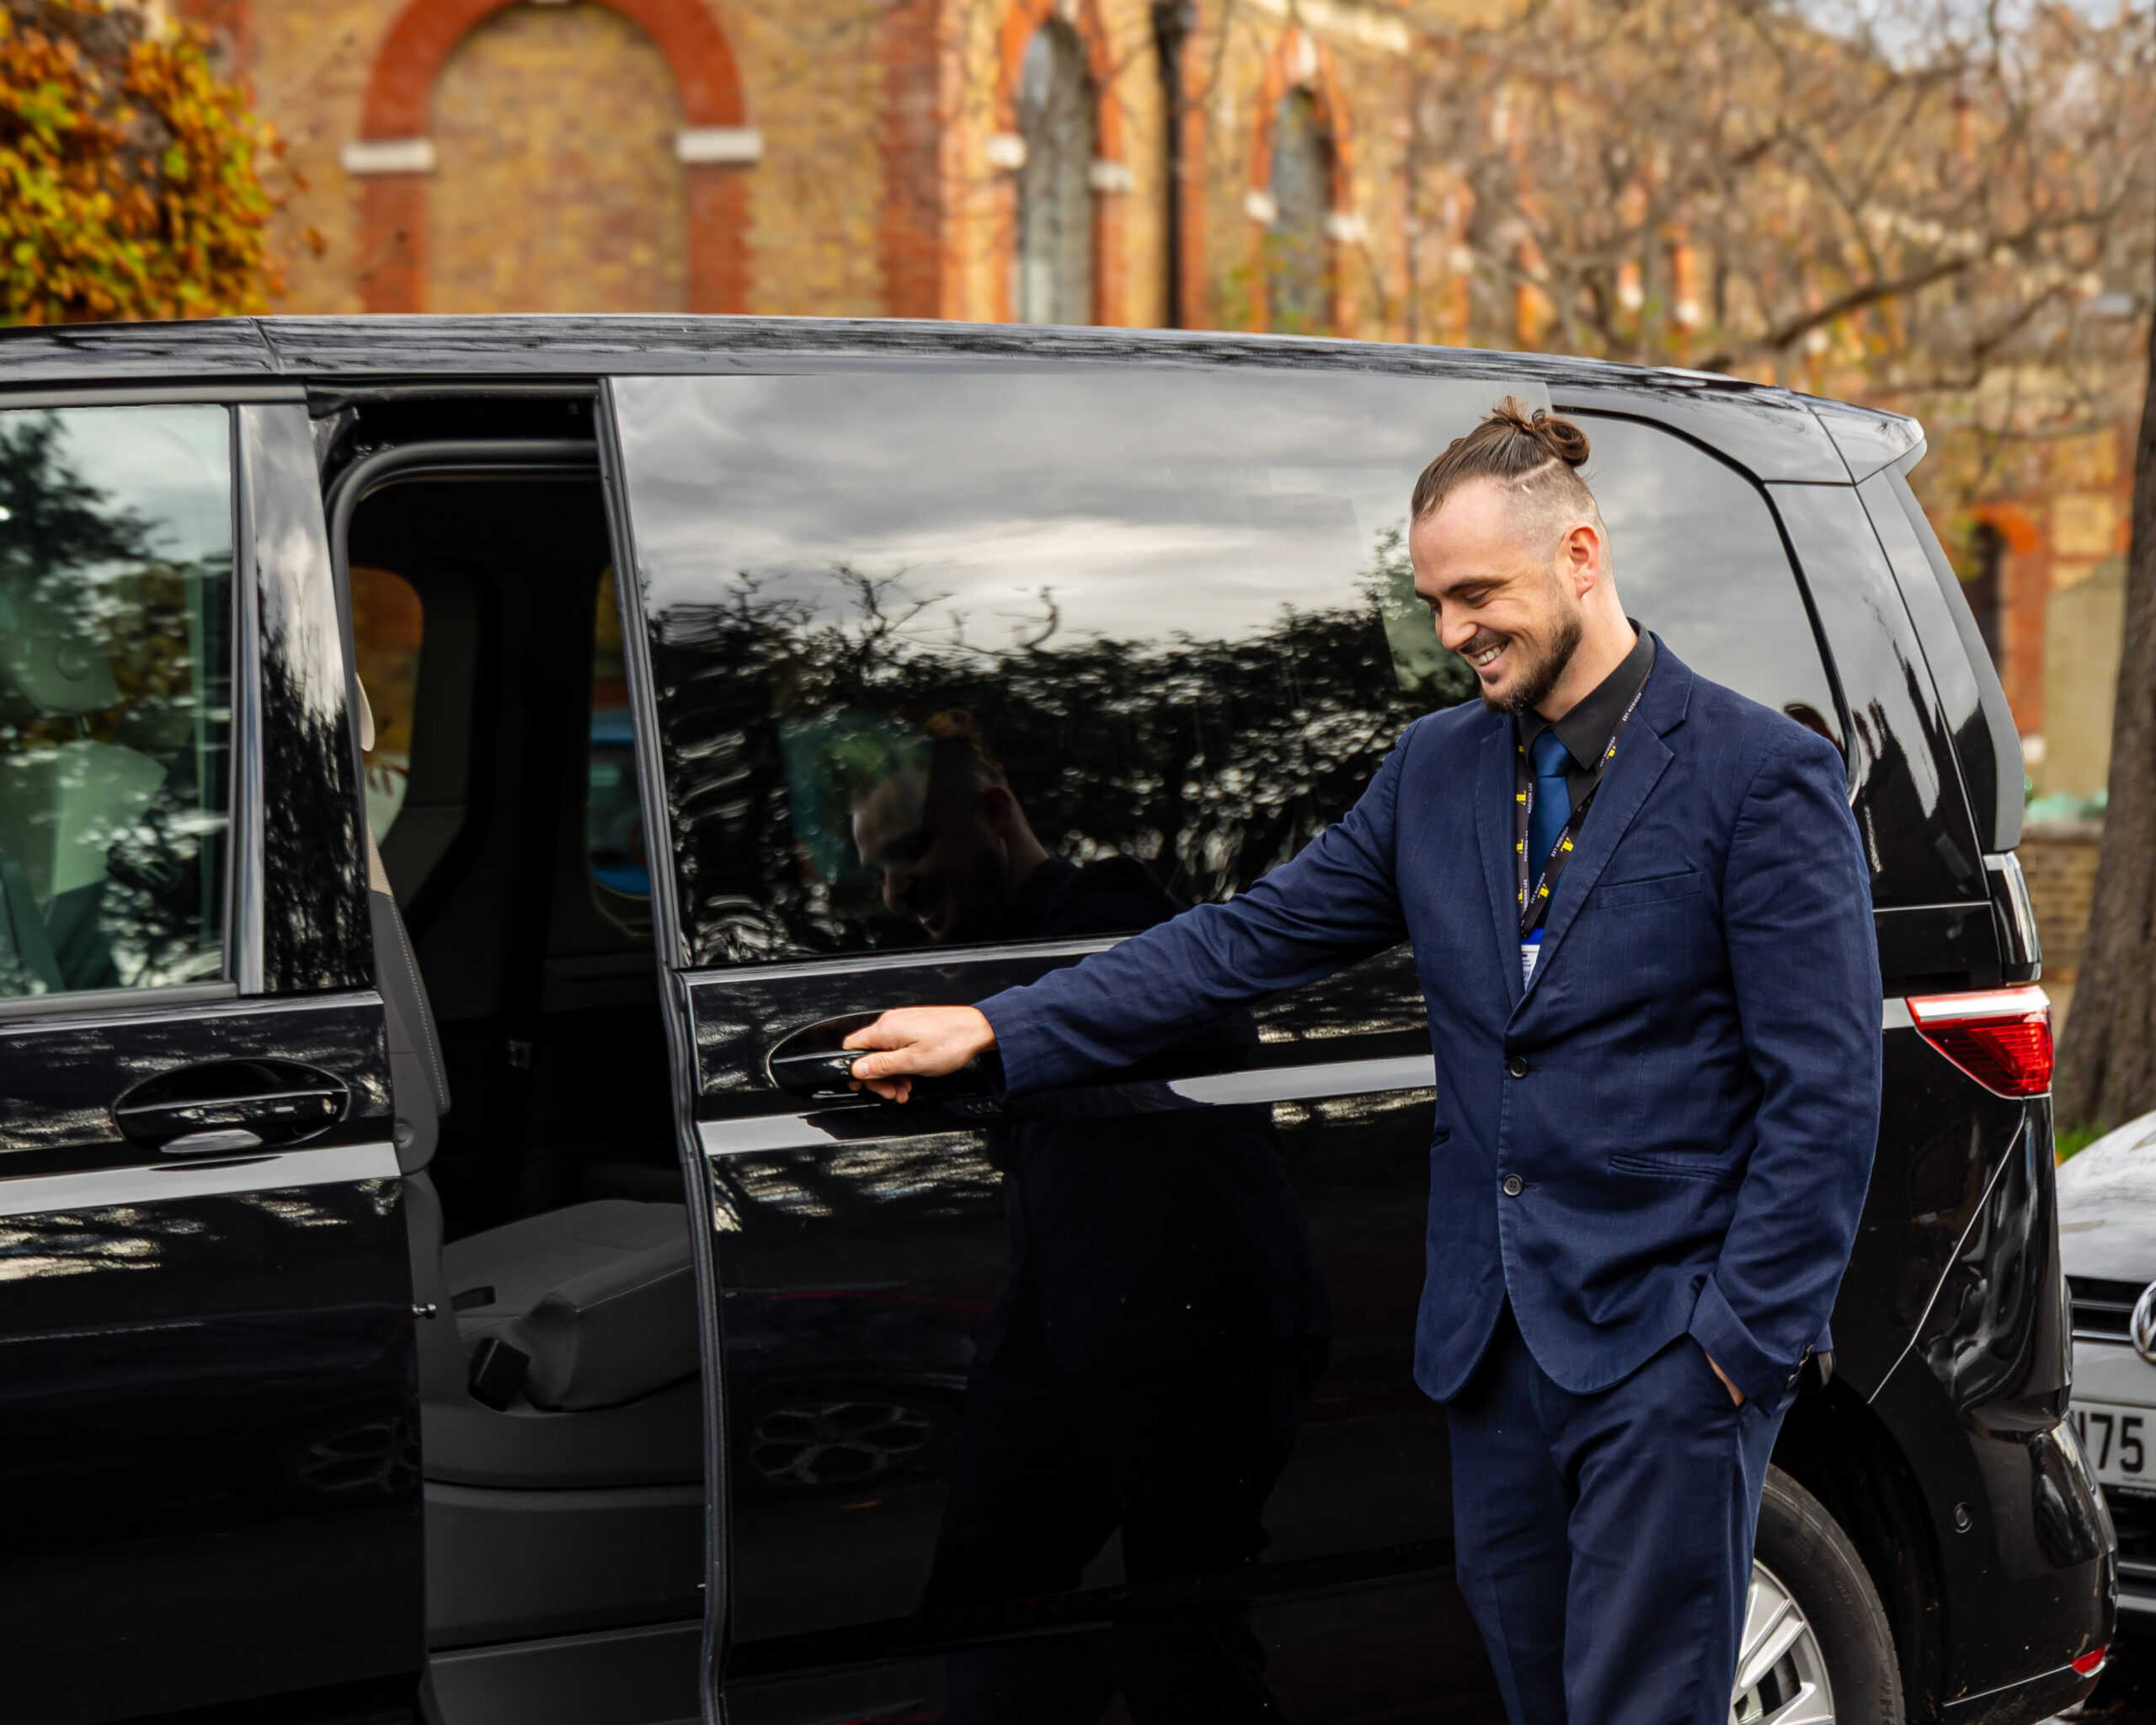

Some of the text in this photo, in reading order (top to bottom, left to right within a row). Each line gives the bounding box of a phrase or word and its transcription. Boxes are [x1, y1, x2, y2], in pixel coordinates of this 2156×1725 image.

[1622, 692, 1641, 722] ADDISON LEE
[1555, 825, 1569, 847] ADDISON
